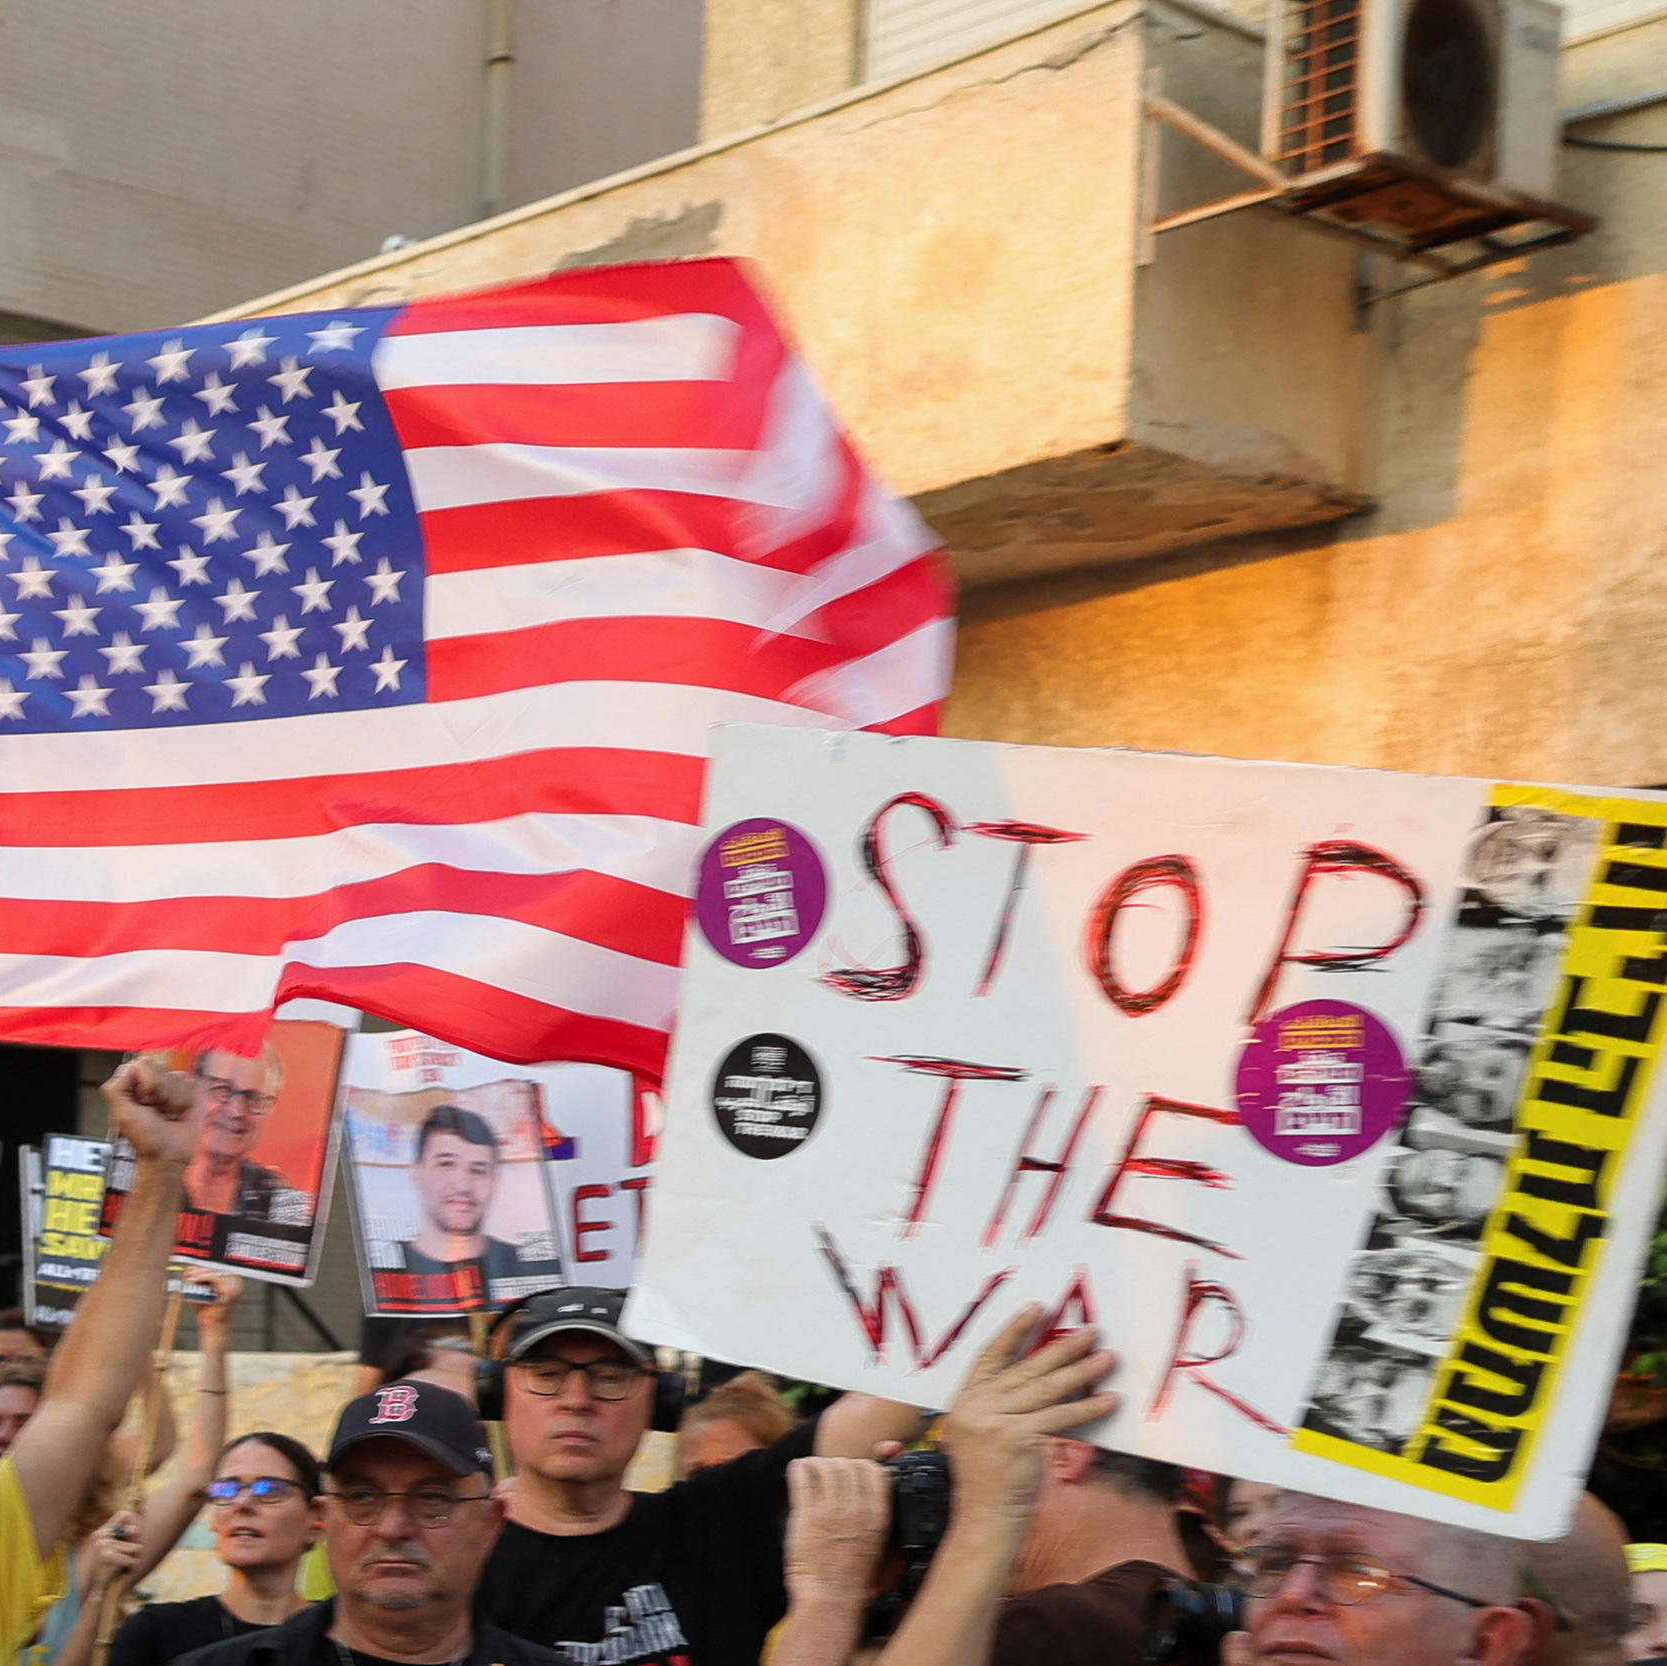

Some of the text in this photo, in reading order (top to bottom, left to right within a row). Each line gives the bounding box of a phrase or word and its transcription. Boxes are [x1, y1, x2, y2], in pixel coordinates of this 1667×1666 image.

[814, 790, 1426, 1030] STOP
[863, 1053, 1250, 1261] THE
[368, 1385, 420, 1425] B
[1420, 1128, 1613, 1484] ממשלת
